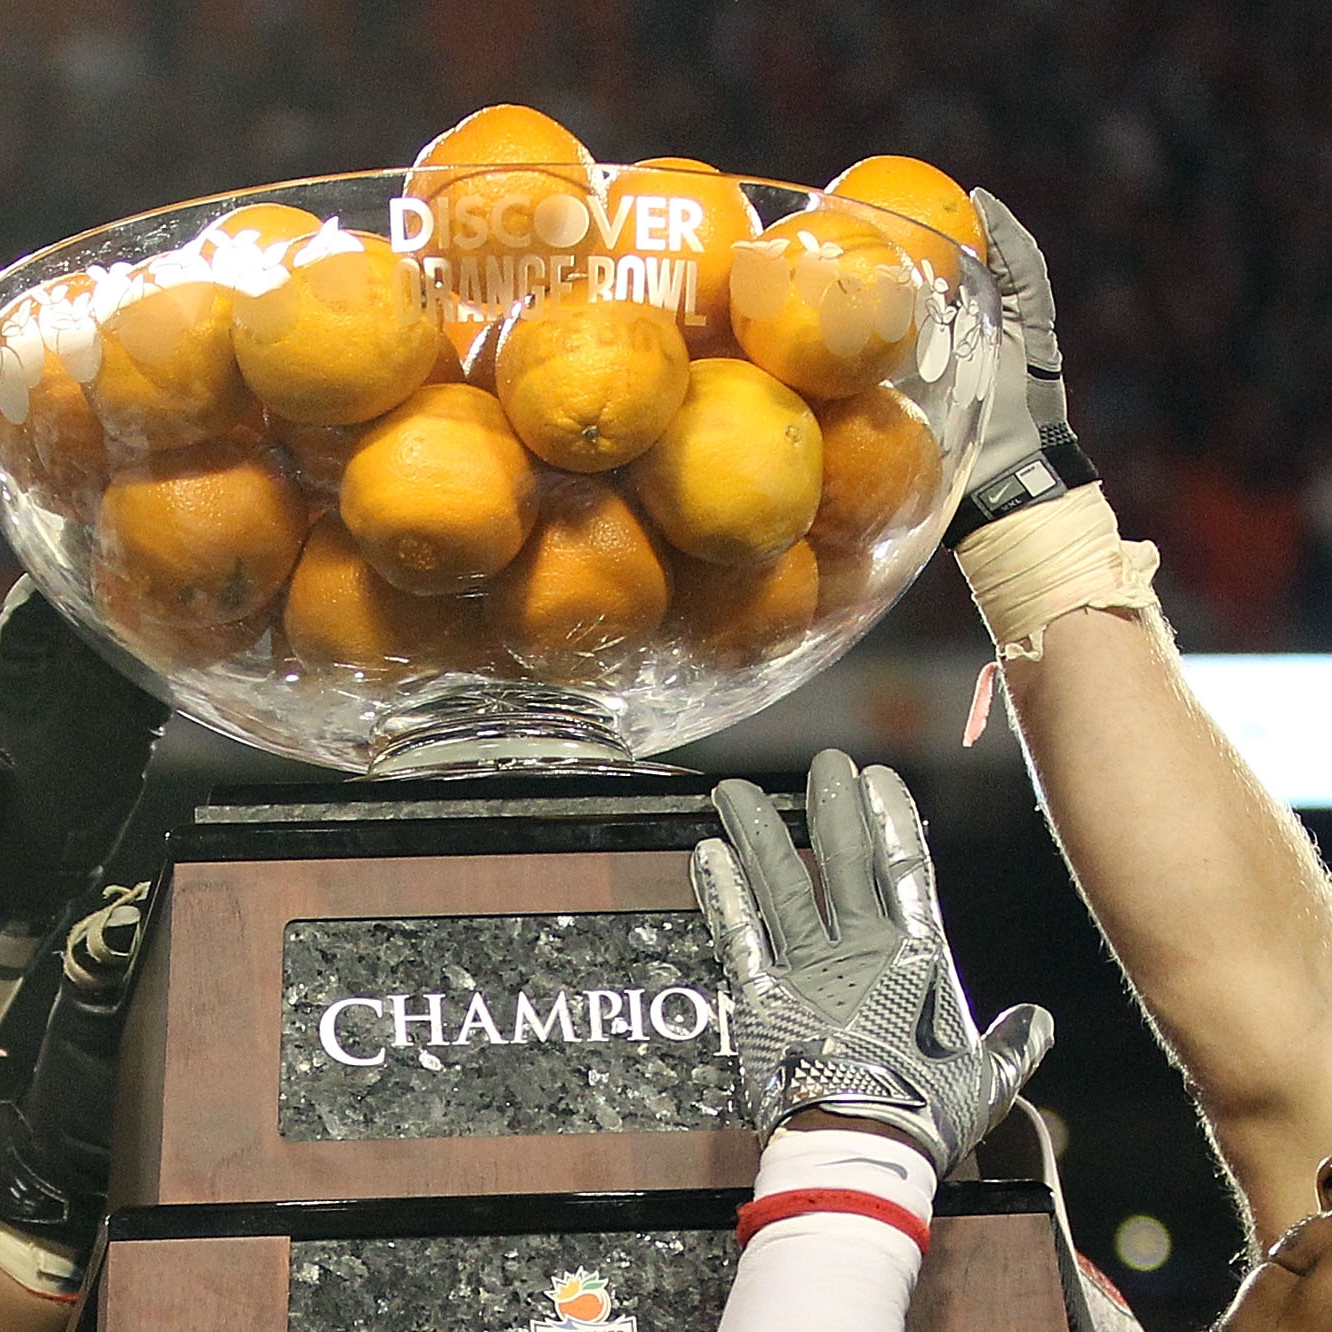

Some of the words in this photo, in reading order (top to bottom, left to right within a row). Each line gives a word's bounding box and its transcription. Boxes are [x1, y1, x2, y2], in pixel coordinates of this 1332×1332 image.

[390, 195, 705, 253] DISCOVER
[393, 255, 576, 323] ORANGE
[588, 255, 707, 326] BOWL
